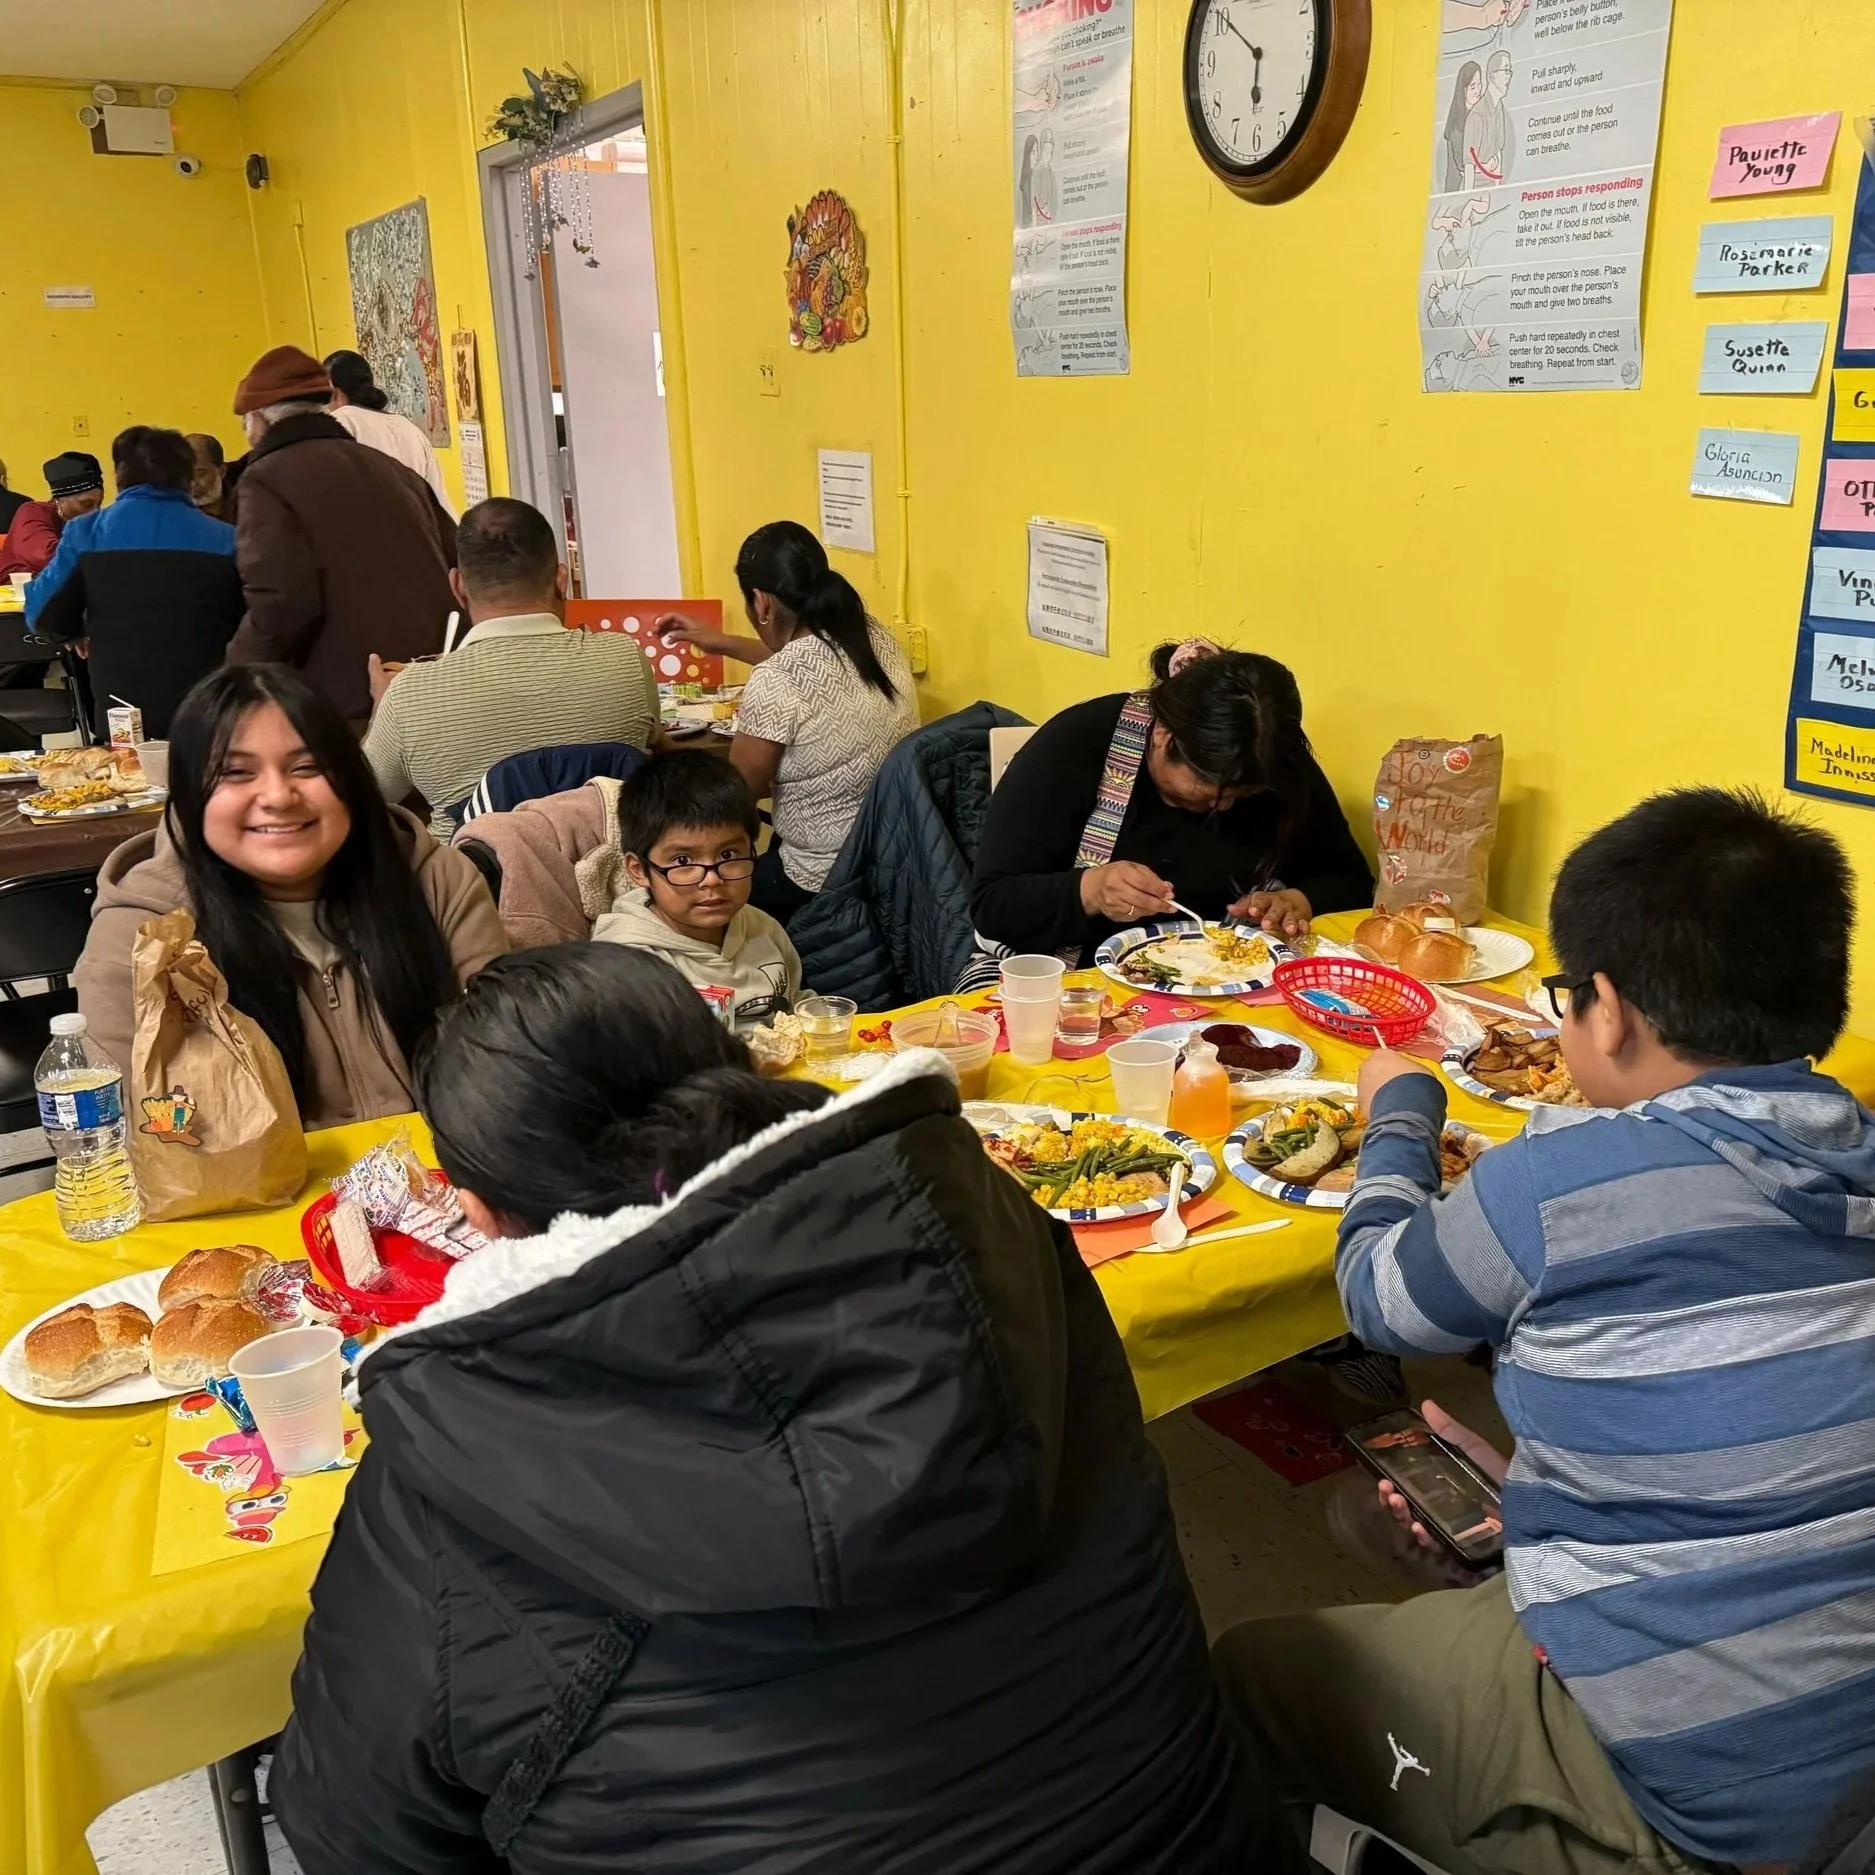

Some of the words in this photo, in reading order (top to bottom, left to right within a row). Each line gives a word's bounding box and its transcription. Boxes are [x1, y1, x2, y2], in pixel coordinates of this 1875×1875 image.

[1213, 7, 1230, 36] 10
[1534, 28, 1549, 39] well
[1550, 23, 1574, 36] below
[1575, 19, 1588, 30] the
[1589, 15, 1601, 27] rib
[1535, 9, 1568, 27] person's
[1569, 5, 1588, 16] belly
[1306, 30, 1315, 60] 3
[1207, 50, 1216, 78] 9
[1532, 68, 1547, 79] Pull
[1548, 62, 1577, 76] sharply,
[1295, 74, 1306, 103] 4
[1530, 80, 1555, 94] inward
[1557, 77, 1572, 89] and
[1212, 90, 1222, 118] 8
[1277, 111, 1286, 139] 5
[1528, 115, 1561, 128] Continue
[1563, 110, 1579, 122] until
[1581, 107, 1593, 118] the
[1595, 103, 1613, 116] food
[1231, 118, 1240, 145] 7
[1252, 124, 1261, 152] 6
[1527, 131, 1551, 142] comes
[1553, 127, 1566, 138] out
[1567, 126, 1575, 135] or
[1576, 123, 1589, 133] the
[1590, 119, 1618, 133] person
[1526, 147, 1539, 156] can
[1541, 141, 1571, 154] breathe.
[1739, 163, 1796, 185] Young
[1521, 190, 1553, 202] Person
[1556, 186, 1583, 198] stops
[1585, 177, 1643, 194] responding
[1519, 209, 1539, 221] Open
[1540, 207, 1552, 217] the
[1554, 205, 1580, 216] mouth.
[1582, 203, 1587, 212] If
[1589, 200, 1606, 211] food
[1608, 200, 1615, 209] is
[1617, 197, 1639, 208] there,
[1517, 224, 1532, 234] take
[1534, 223, 1540, 232] it
[1557, 220, 1562, 229] If
[1563, 218, 1580, 228] food
[1582, 218, 1588, 227] is
[1590, 216, 1604, 225] not
[1605, 212, 1632, 223] visible,
[1515, 239, 1524, 247] tilt
[1525, 237, 1537, 246] the
[1538, 233, 1570, 247] person's
[1572, 231, 1592, 241] head
[1719, 243, 1813, 262] Rosemarie
[1511, 273, 1531, 282] Pinch
[1533, 273, 1545, 281] the
[1546, 269, 1579, 282] person's
[1580, 268, 1601, 277] nose.
[1603, 265, 1627, 275] Place
[1510, 289, 1526, 298] your
[1528, 285, 1551, 295] mouth
[1552, 285, 1569, 294] over
[1571, 283, 1583, 292] the
[1584, 279, 1619, 293] person's
[1510, 300, 1532, 310] mouth
[1534, 300, 1548, 308] and
[1549, 299, 1565, 310] give
[1567, 297, 1580, 306] two
[1582, 294, 1614, 305] breaths.
[1509, 333, 1528, 342] Push
[1529, 332, 1546, 341] hard
[1547, 330, 1587, 342] repeatedly
[1589, 330, 1596, 339] in
[1598, 329, 1620, 338] chest
[1509, 347, 1531, 356] center
[1533, 346, 1543, 355] for
[1545, 346, 1554, 355] 20
[1556, 344, 1590, 353] seconds.
[1592, 343, 1619, 353] Check
[1724, 339, 1790, 357] Susette
[1547, 359, 1575, 369] Repeat
[1576, 358, 1594, 367] from
[1596, 357, 1616, 367] start.
[1732, 358, 1786, 375] Quinn
[1509, 376, 1524, 384] NYC
[1705, 443, 1750, 464] Gloria
[1717, 461, 1783, 483] Asuncion
[1429, 795, 1465, 821] the
[1376, 819, 1449, 856] World
